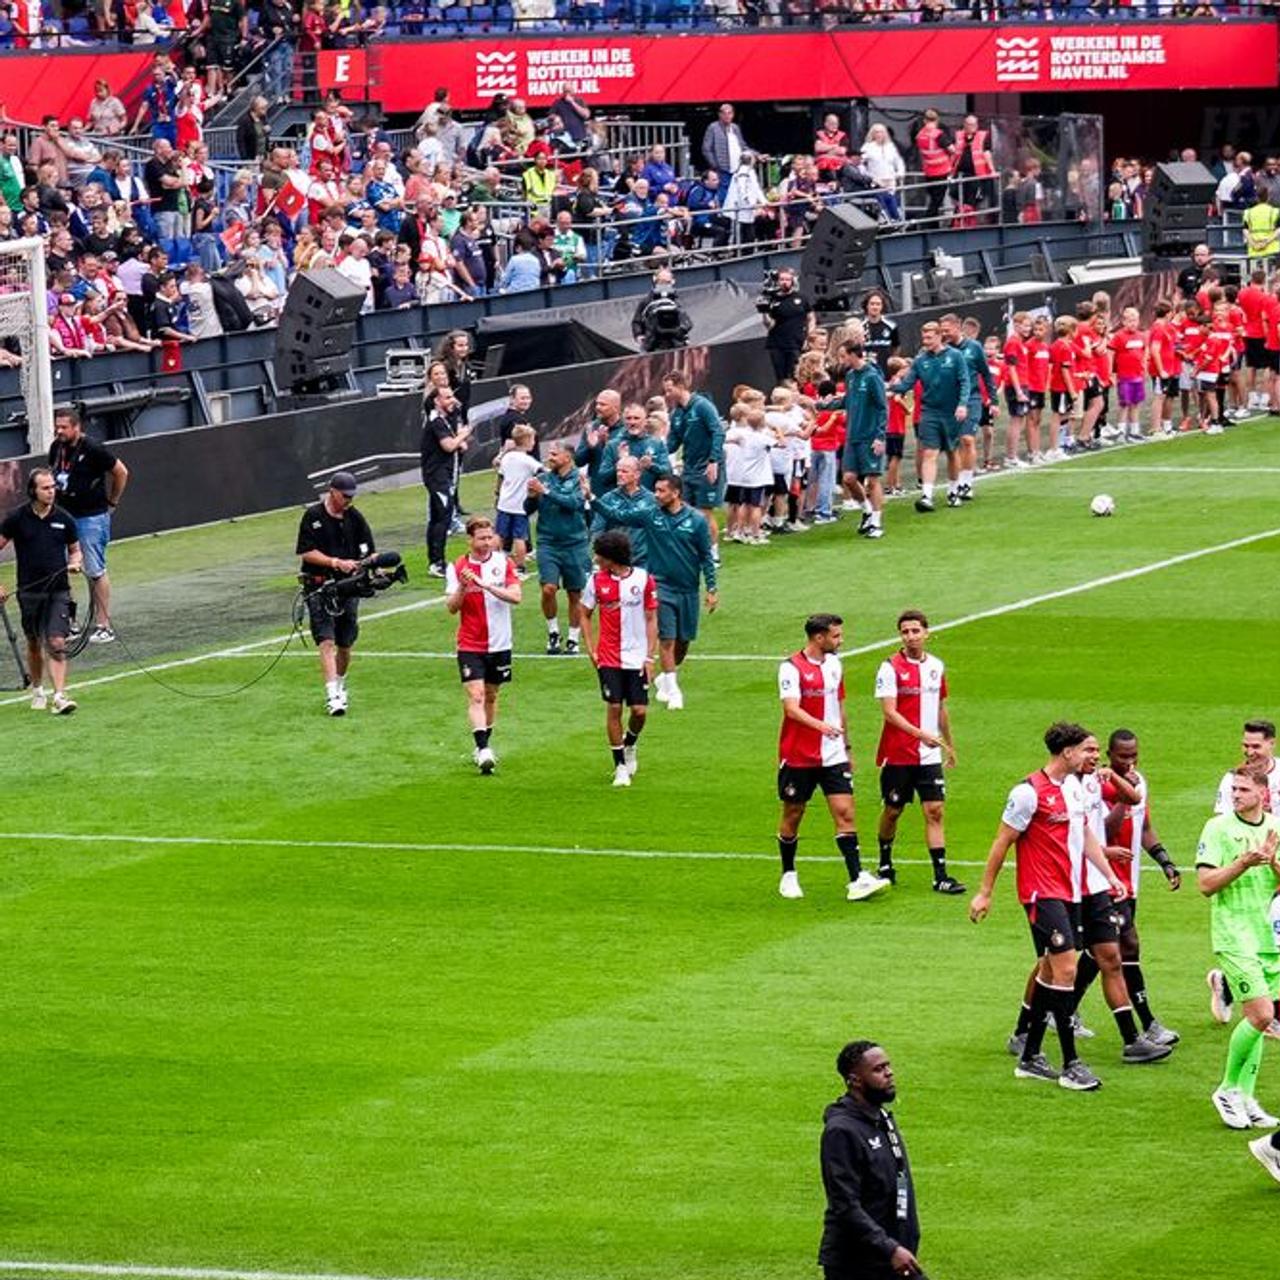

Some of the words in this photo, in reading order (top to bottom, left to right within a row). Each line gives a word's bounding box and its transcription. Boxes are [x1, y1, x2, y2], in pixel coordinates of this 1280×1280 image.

[1050, 36, 1117, 50] WERKEN
[1121, 36, 1137, 49] IN
[1141, 35, 1162, 49] DE
[527, 50, 589, 64] WERKEN
[592, 49, 608, 63] IN
[611, 48, 631, 62] DE
[1051, 50, 1166, 65] ROTTERDAMSE
[335, 54, 351, 82] E
[527, 64, 635, 80] ROTTERDAMSE
[1051, 65, 1129, 80] HAVEN.NL
